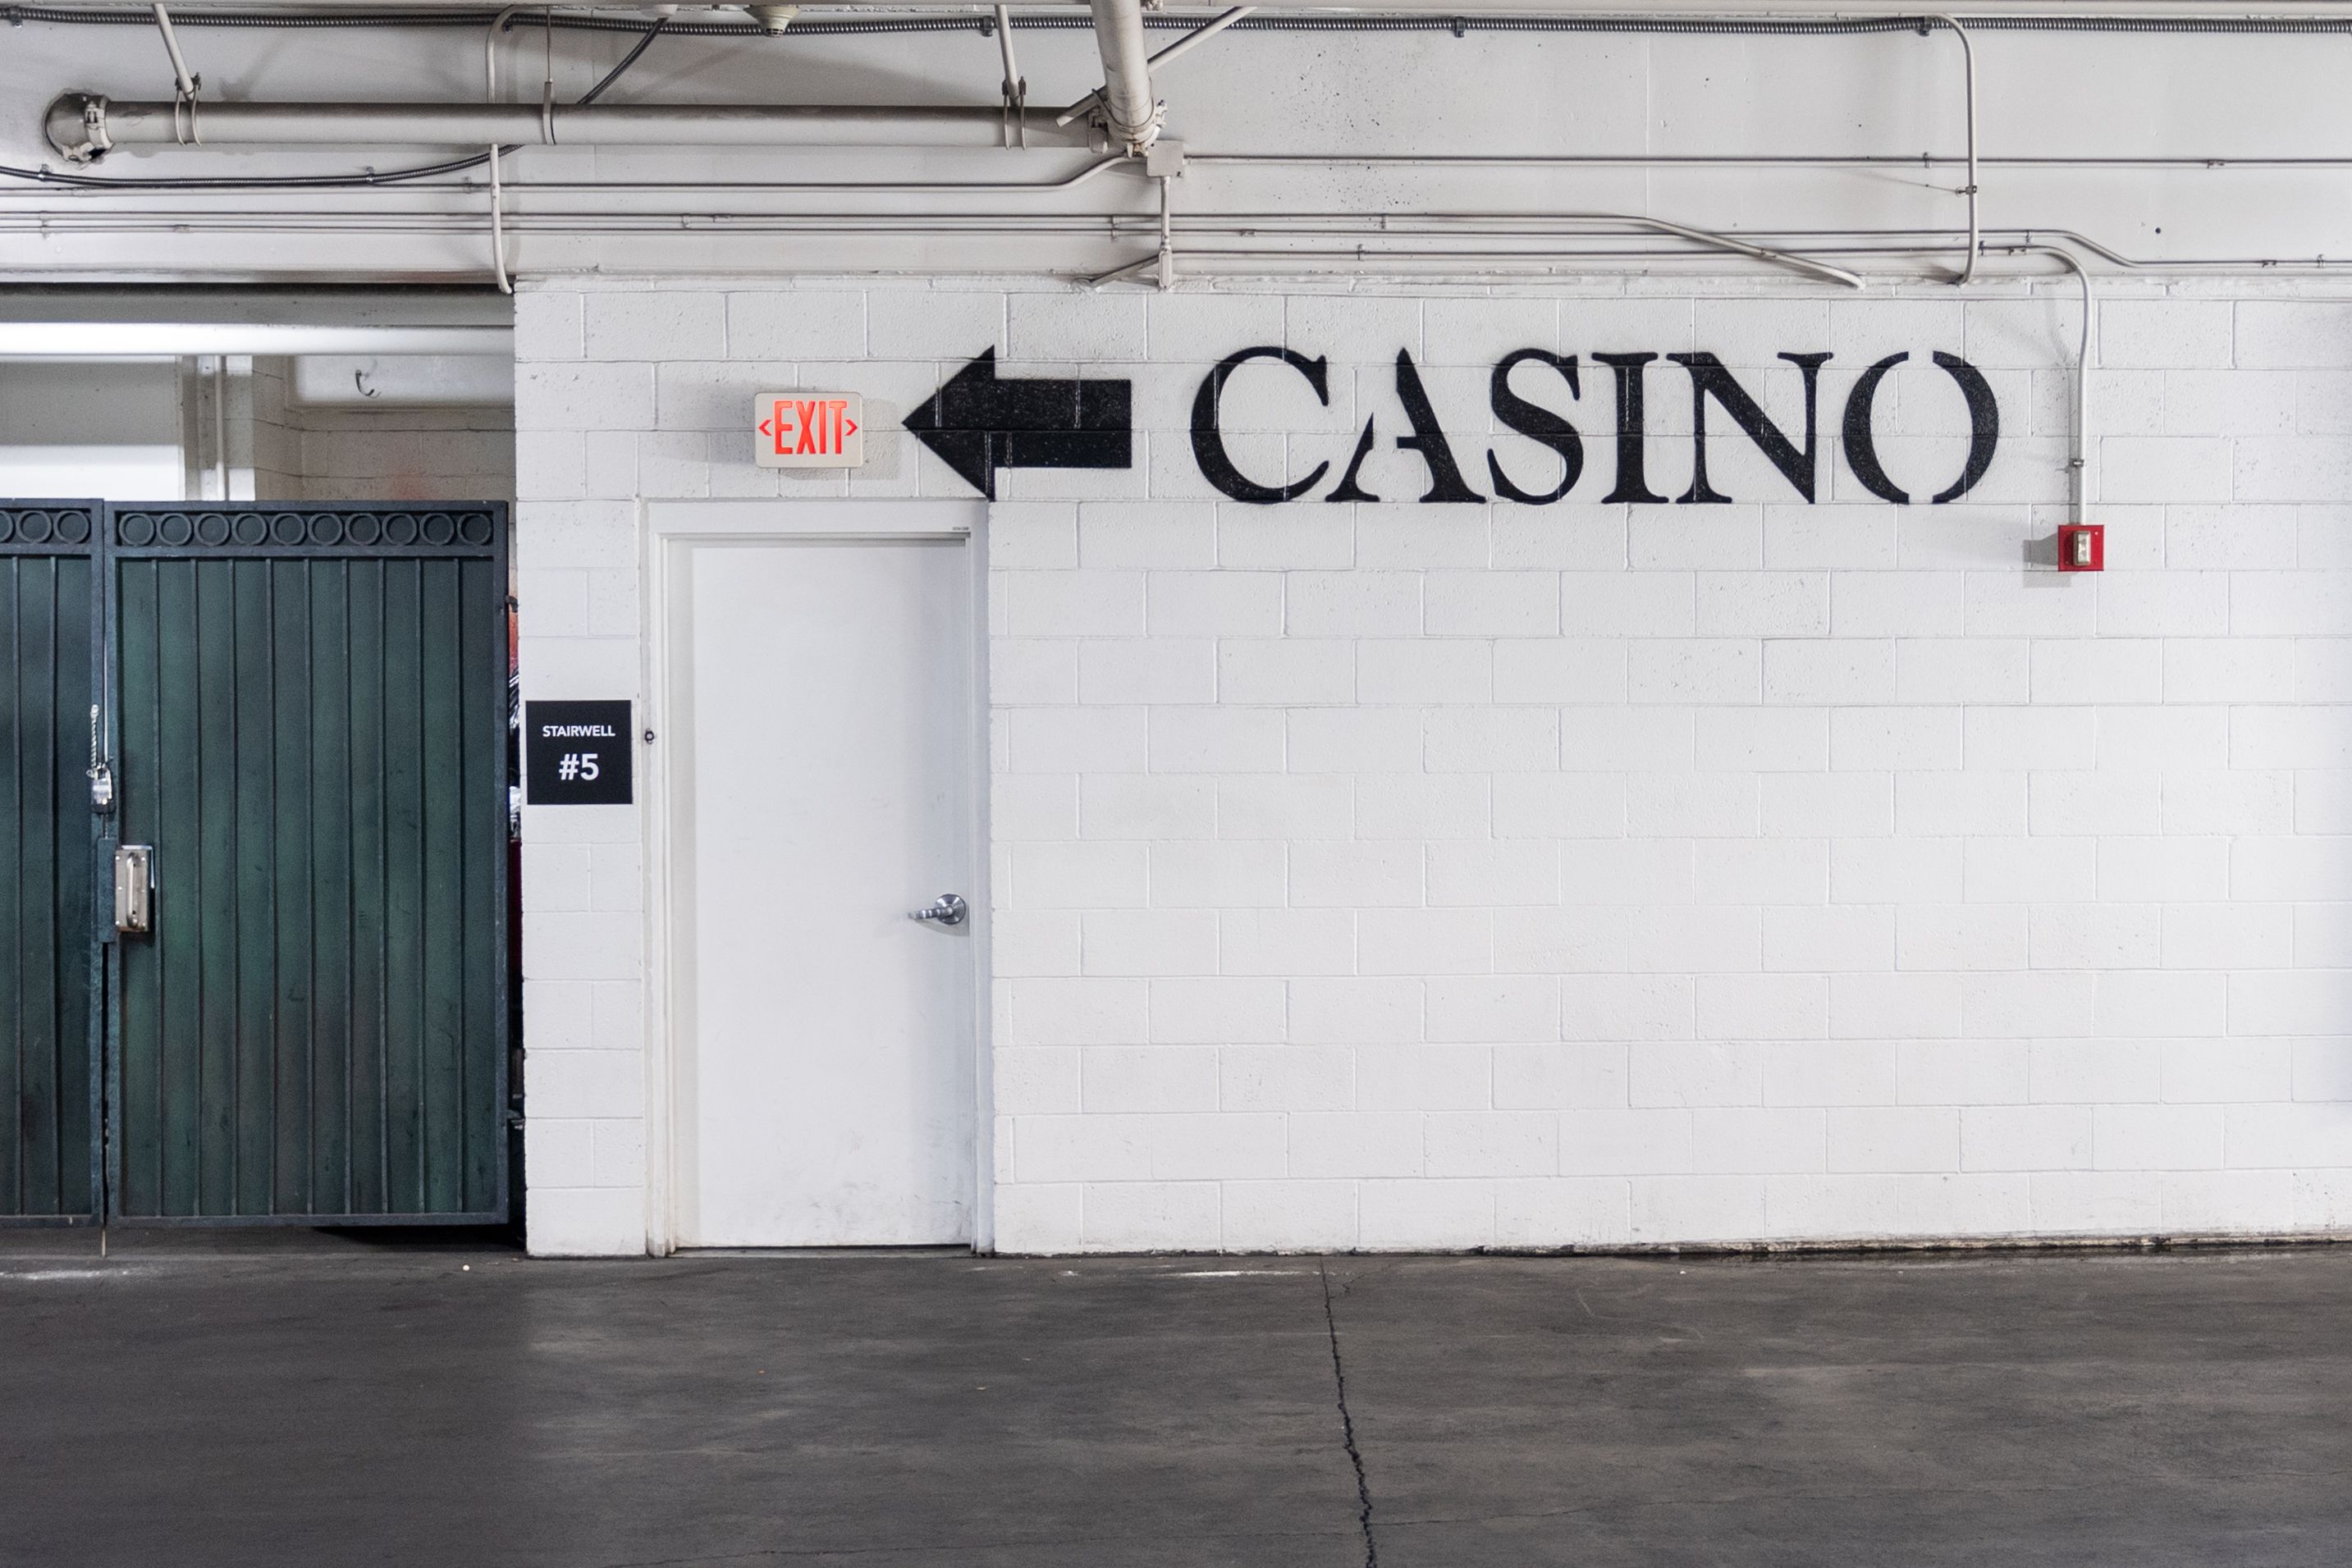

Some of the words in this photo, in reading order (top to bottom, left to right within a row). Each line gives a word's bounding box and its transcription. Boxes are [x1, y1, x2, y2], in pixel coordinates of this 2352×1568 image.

[774, 400, 848, 455] EXIT
[1190, 346, 1998, 505] CASINO
[542, 725, 615, 738] STAIRWELL
[559, 753, 599, 780] #5
